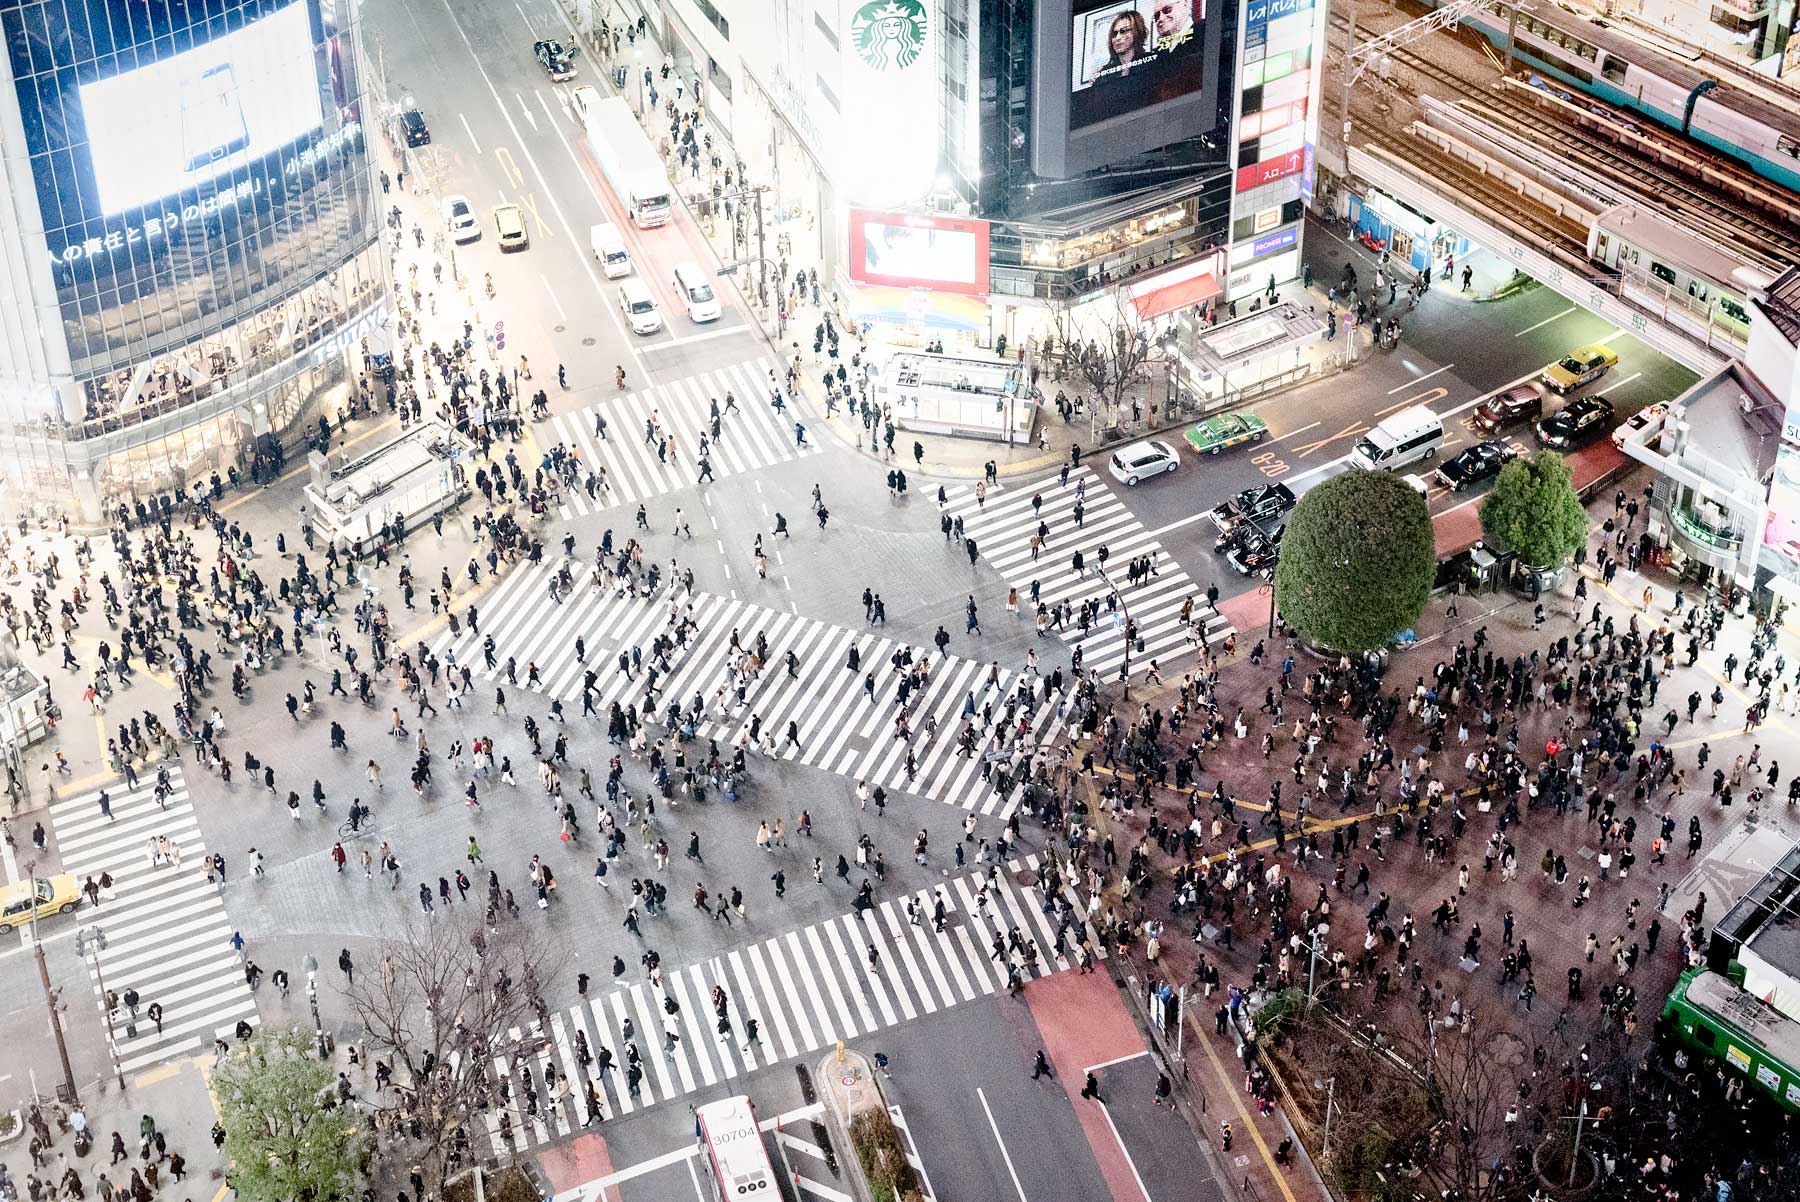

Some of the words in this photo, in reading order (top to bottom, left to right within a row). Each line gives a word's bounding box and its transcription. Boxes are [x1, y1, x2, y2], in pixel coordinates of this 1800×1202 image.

[1263, 168, 1280, 180] 入口
[1255, 237, 1281, 252] PROMISE
[313, 305, 386, 363] TSUTAYA
[1250, 452, 1290, 477] 8-20
[713, 1127, 755, 1146] 30704
